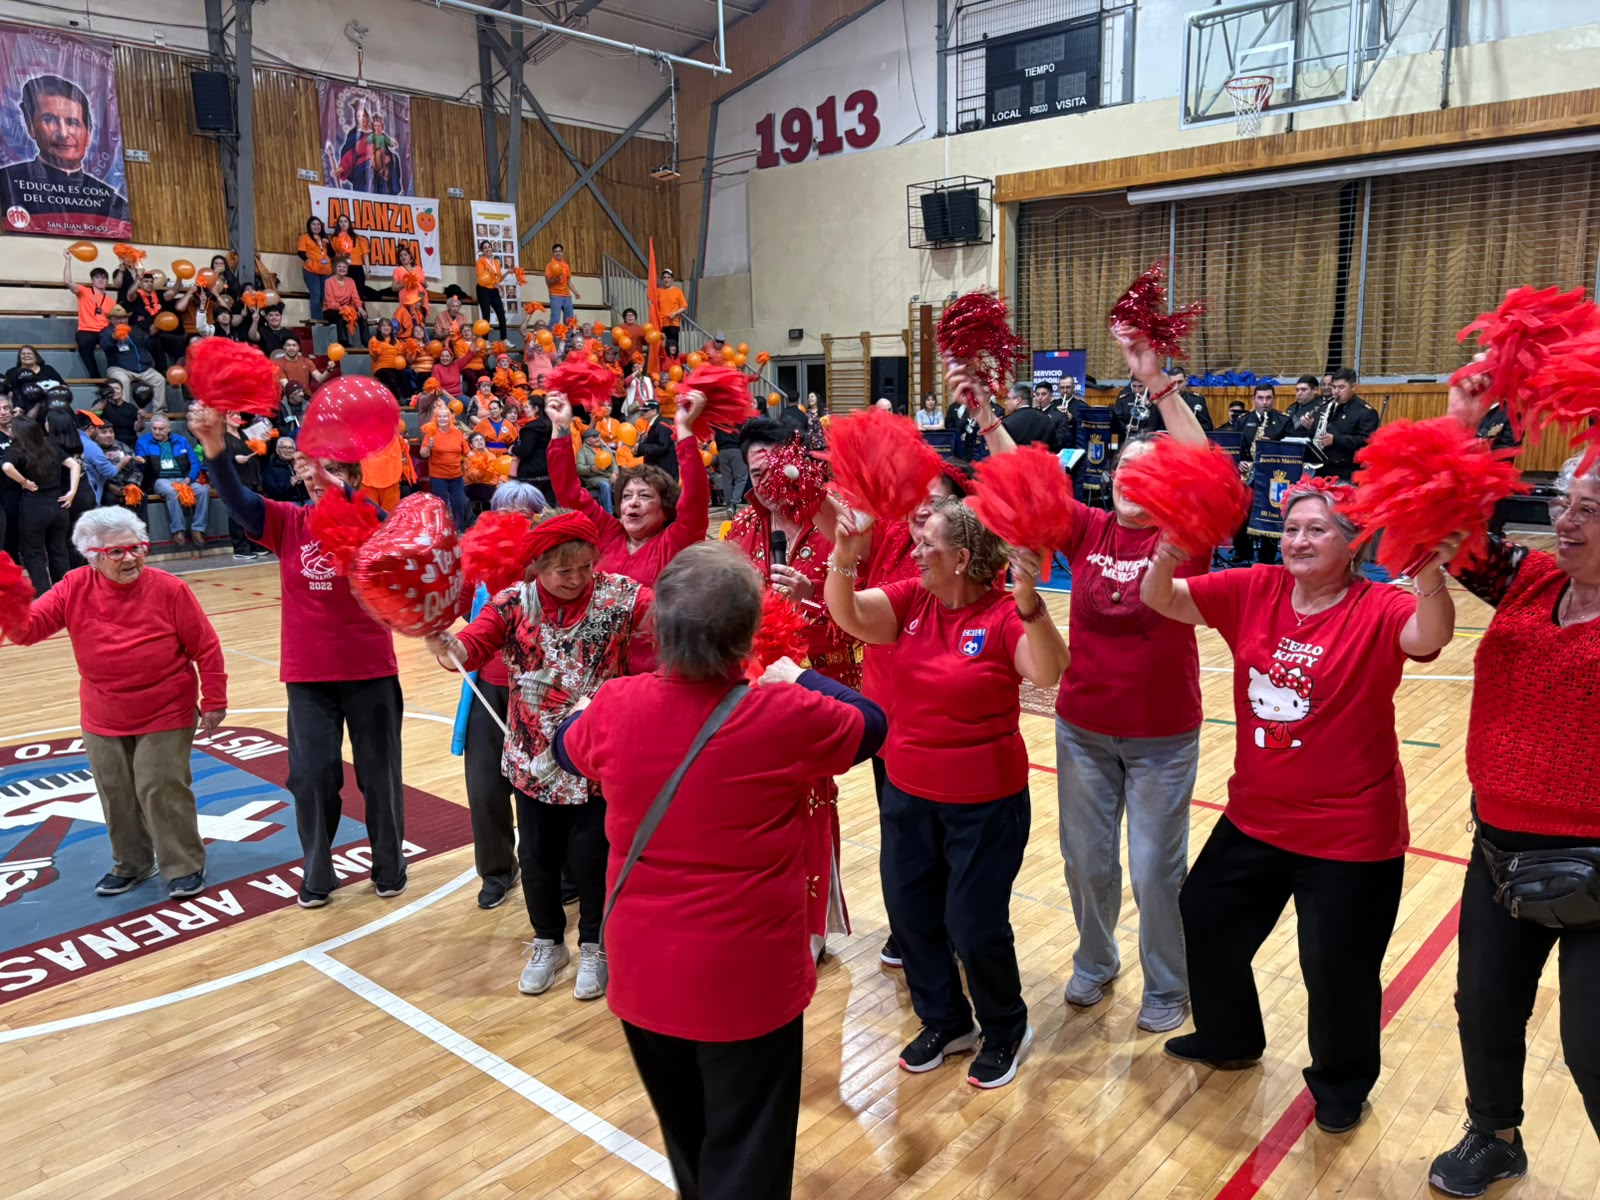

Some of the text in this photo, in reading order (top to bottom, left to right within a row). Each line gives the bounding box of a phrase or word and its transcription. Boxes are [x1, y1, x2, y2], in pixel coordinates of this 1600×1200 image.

[1024, 63, 1055, 78] TIEMPO
[992, 109, 1022, 122] LOCAL
[1056, 96, 1087, 110] VISITA
[756, 89, 881, 170] 1913
[24, 193, 45, 203] DEL
[68, 185, 80, 194] ES
[83, 187, 110, 197] COSA
[328, 197, 415, 235] ALIANZA
[48, 221, 108, 232] SAN JUAN BOSCO
[1102, 566, 1139, 583] MEXICO
[308, 581, 333, 591] 2022
[963, 629, 985, 637] CHILE
[1278, 636, 1324, 656] HELLO
[1272, 649, 1319, 668] KITTY
[0, 889, 247, 992] ARENAS
